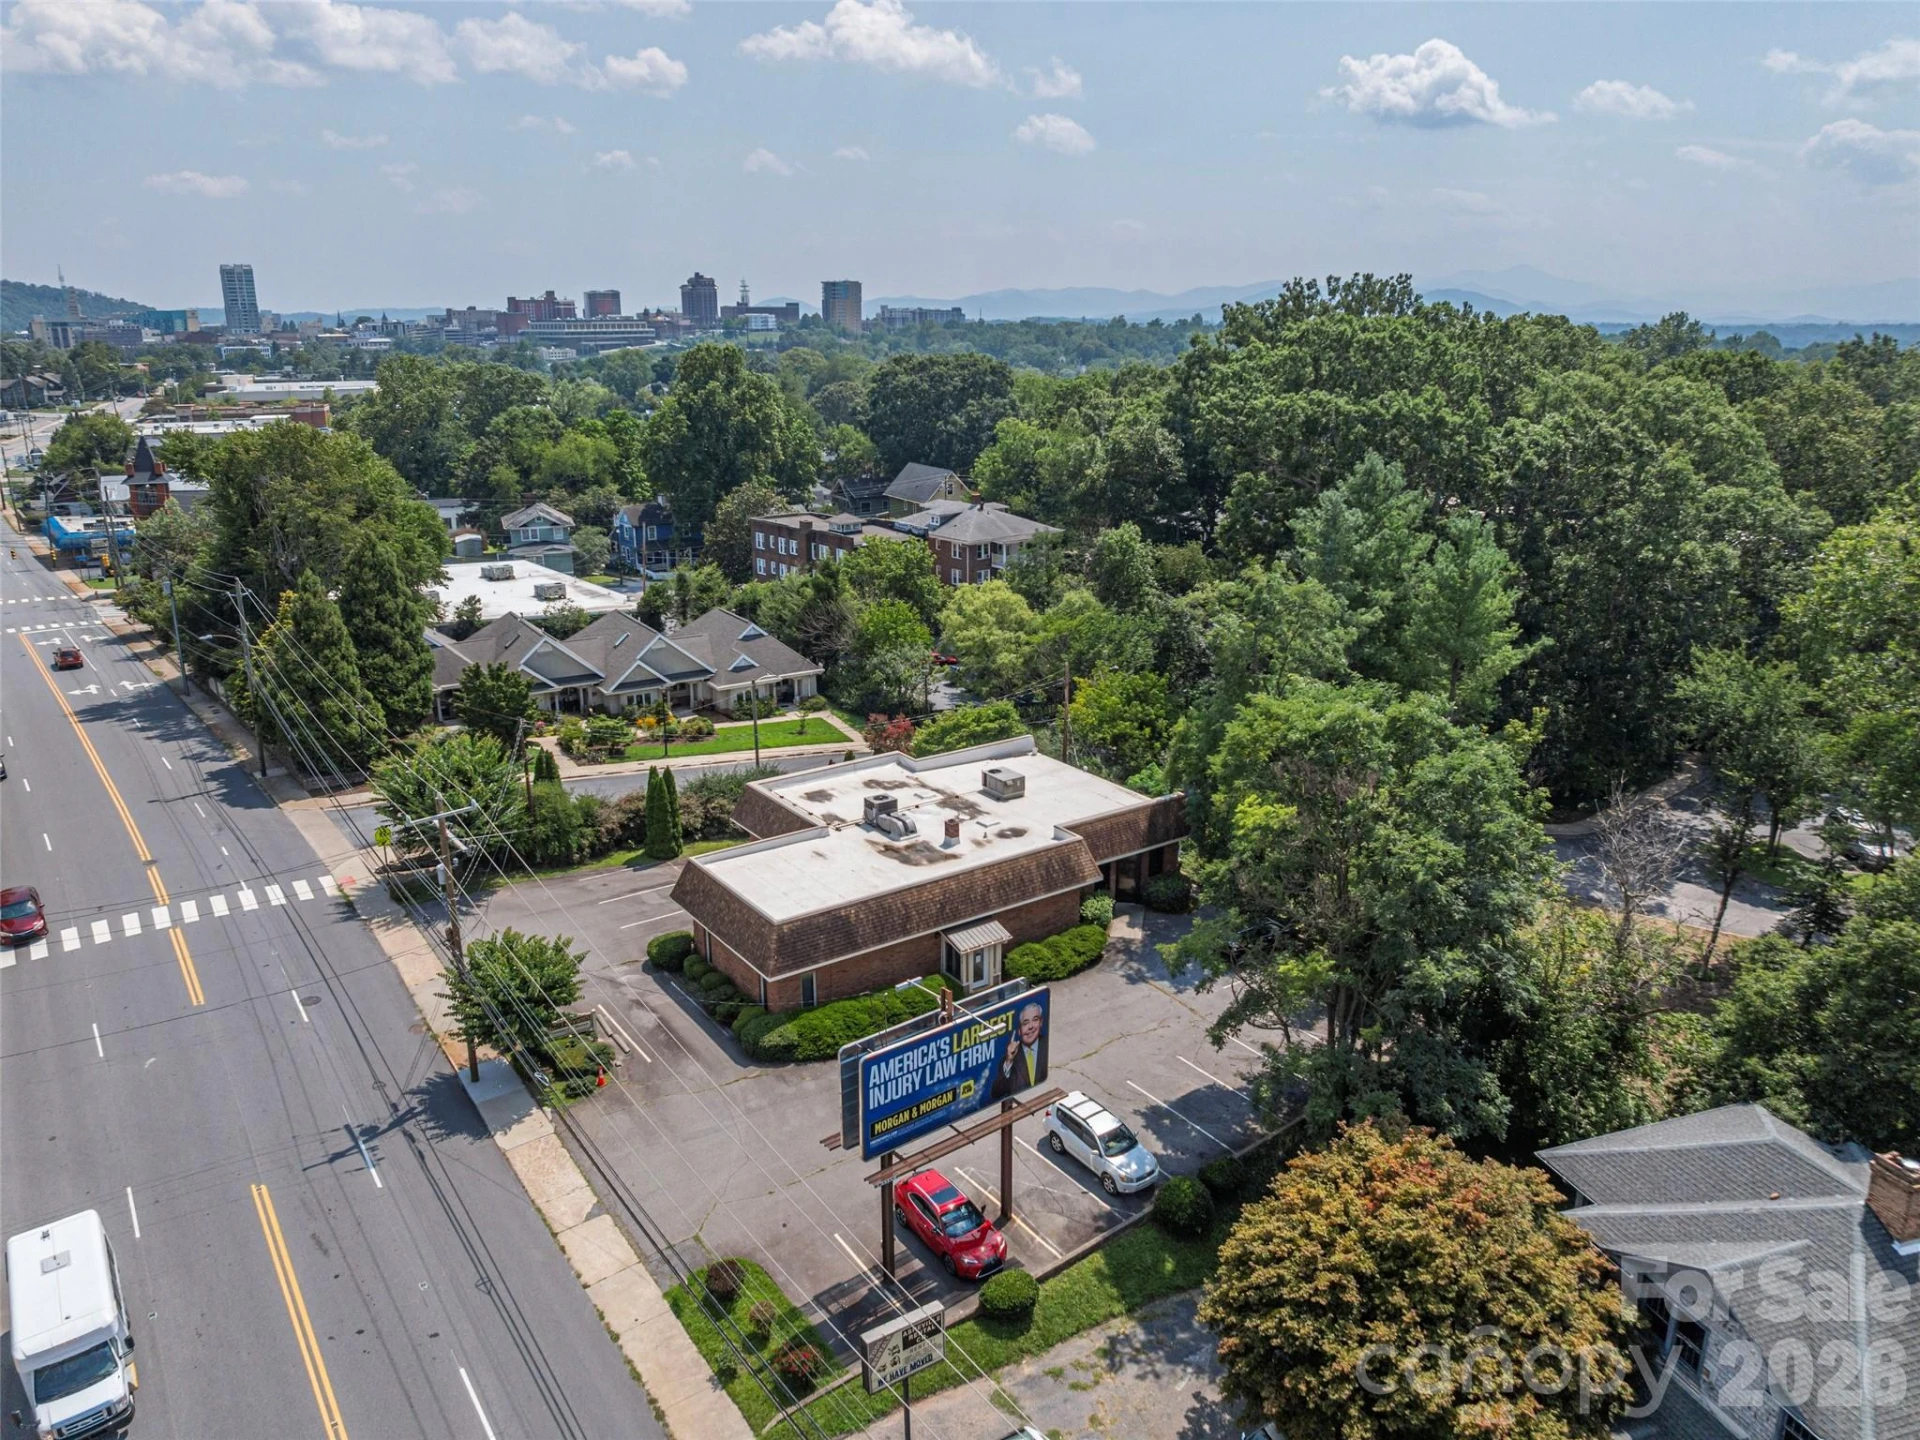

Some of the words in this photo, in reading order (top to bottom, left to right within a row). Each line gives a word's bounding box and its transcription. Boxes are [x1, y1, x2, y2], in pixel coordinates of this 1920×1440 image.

[869, 1036, 950, 1088] AMERICA'S
[869, 1068, 922, 1110] INJURY
[926, 1054, 957, 1086] LAW
[960, 1039, 996, 1071] FIRM
[874, 1110, 910, 1135] MORGAN
[911, 1106, 918, 1118] &
[920, 1091, 953, 1115] MORGAN
[889, 1366, 908, 1380] HAVE
[910, 1353, 933, 1371] MOVED
